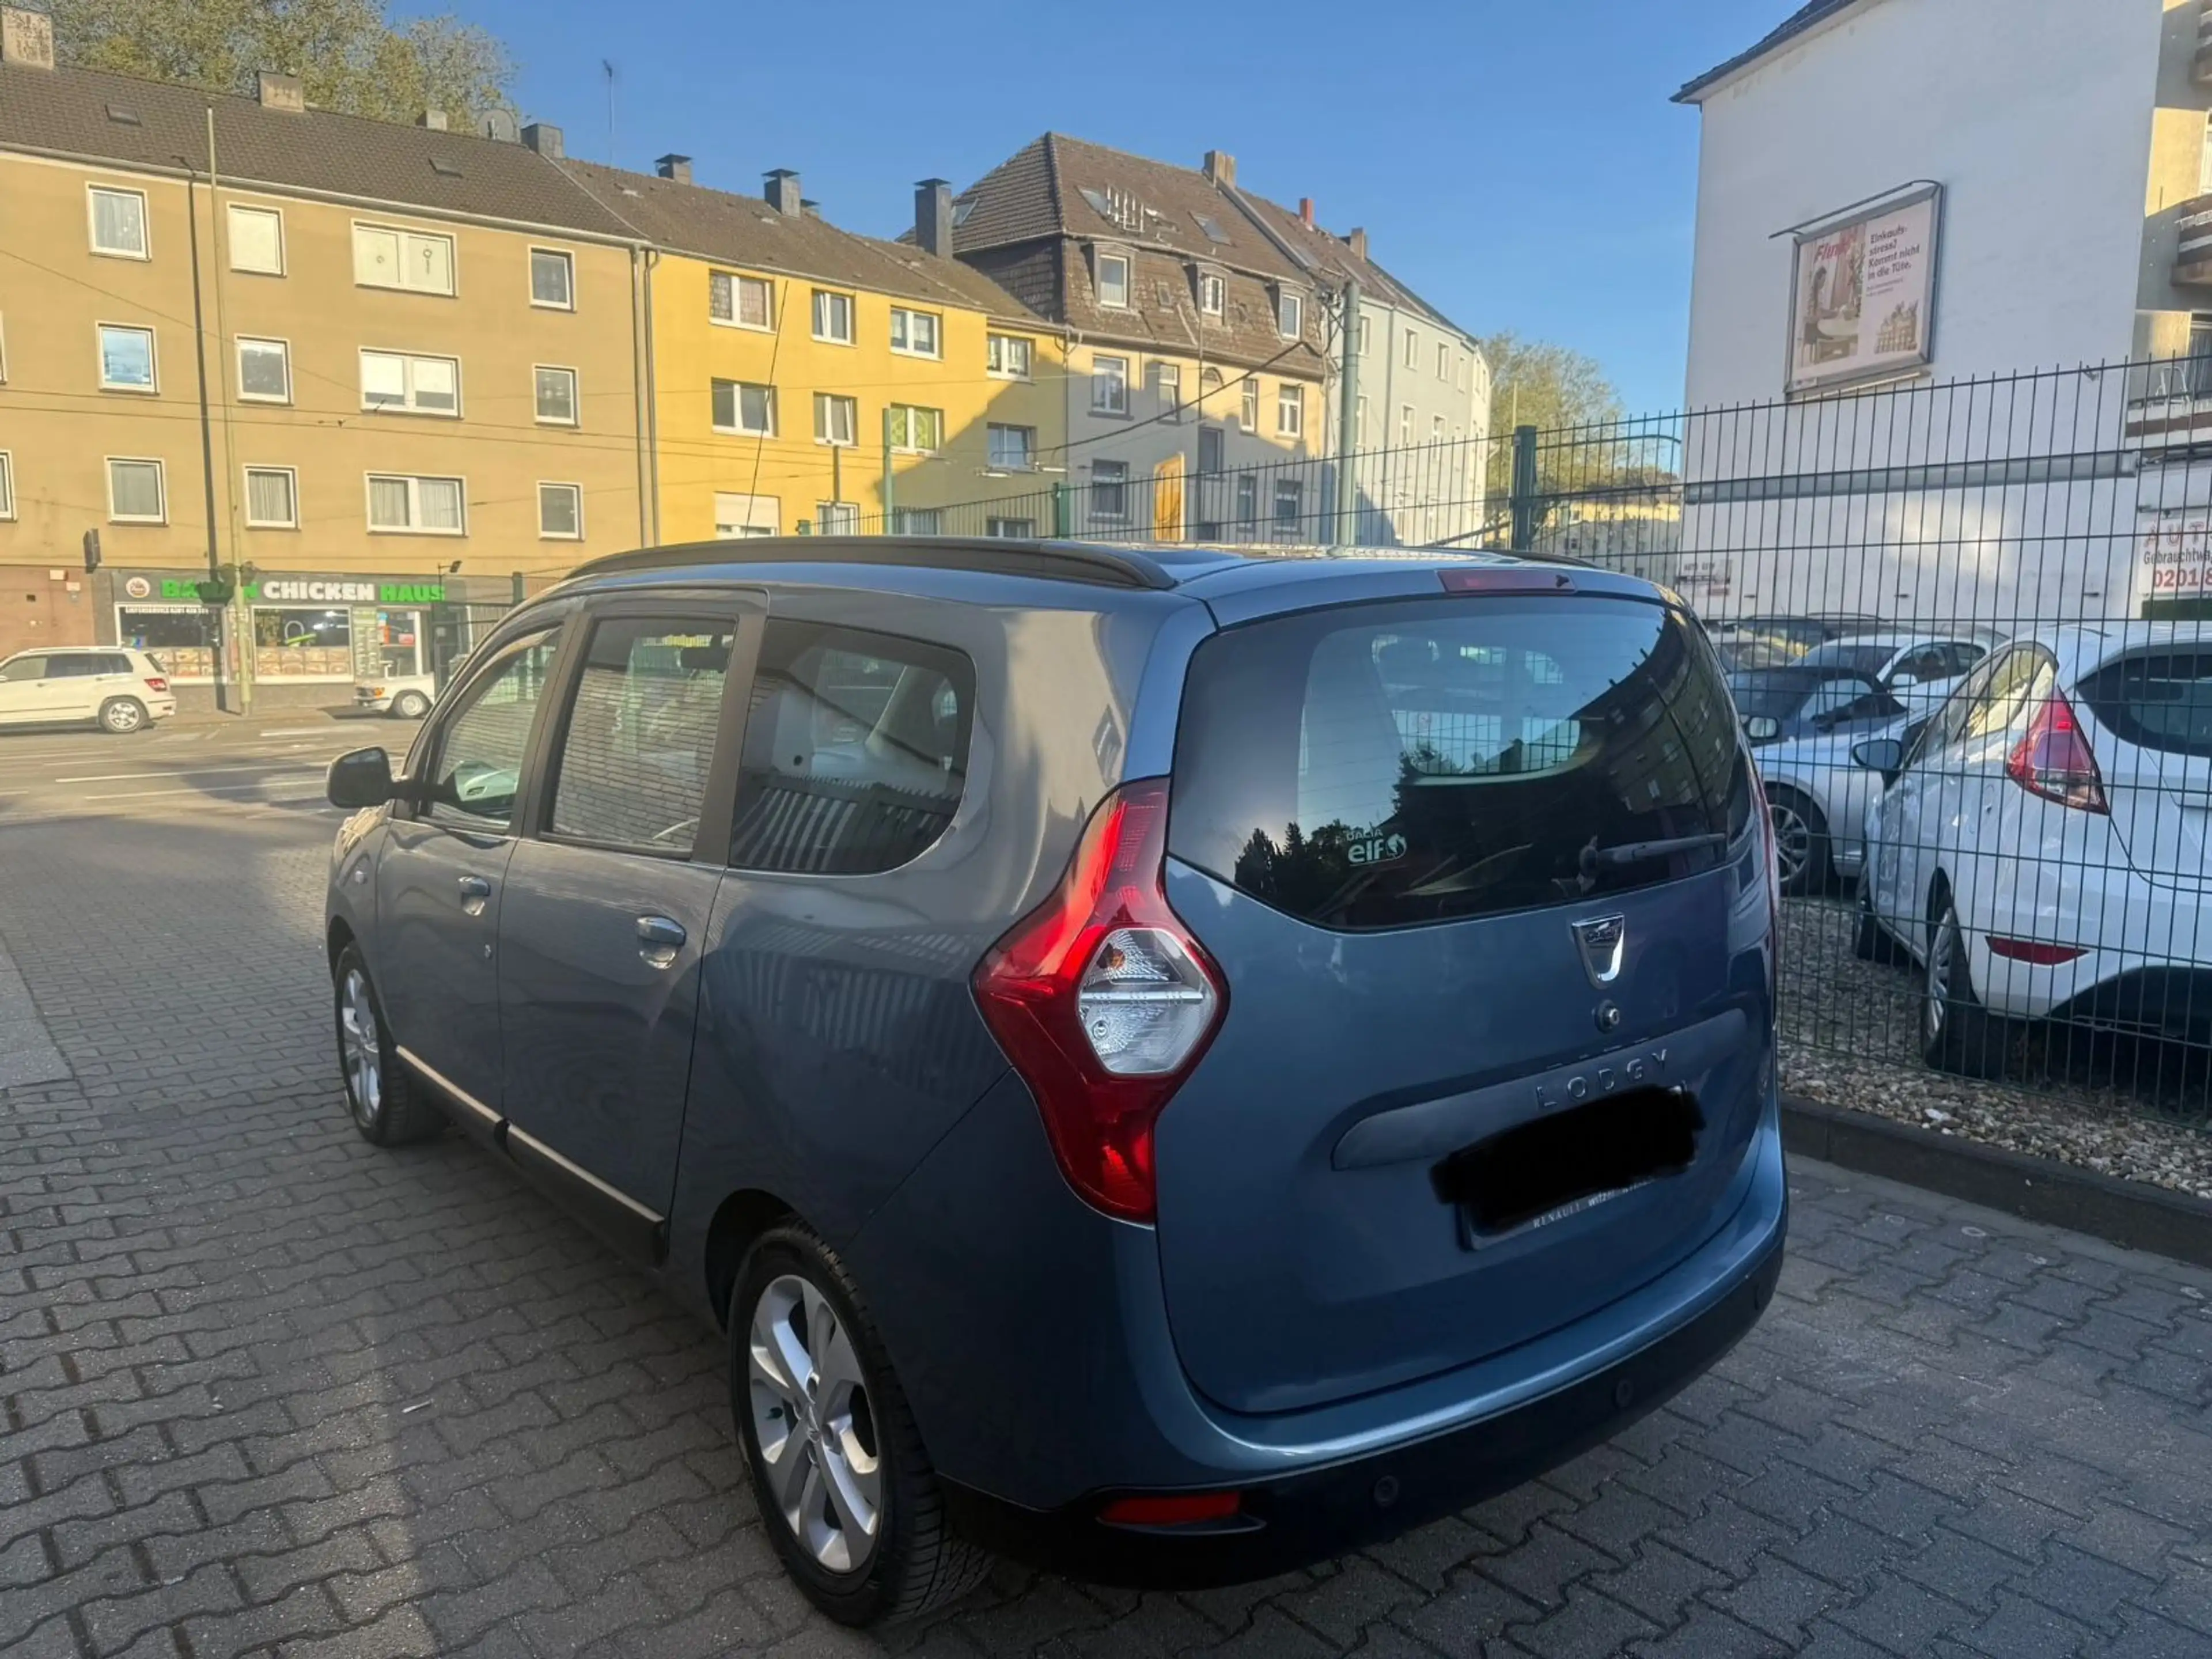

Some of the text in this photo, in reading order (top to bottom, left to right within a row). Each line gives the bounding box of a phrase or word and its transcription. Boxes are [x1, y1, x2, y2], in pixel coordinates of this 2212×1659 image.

[1869, 244, 1920, 268] Kommt nicht
[1877, 266, 1890, 277] die
[2143, 521, 2212, 548] AUT
[2143, 547, 2212, 565] Gebrauchtwa
[2154, 567, 2200, 588] 0201
[263, 581, 374, 601] CHICKEN
[380, 584, 446, 601] HAUS
[1349, 839, 1384, 862] elf
[1536, 1049, 1667, 1108] LODGY
